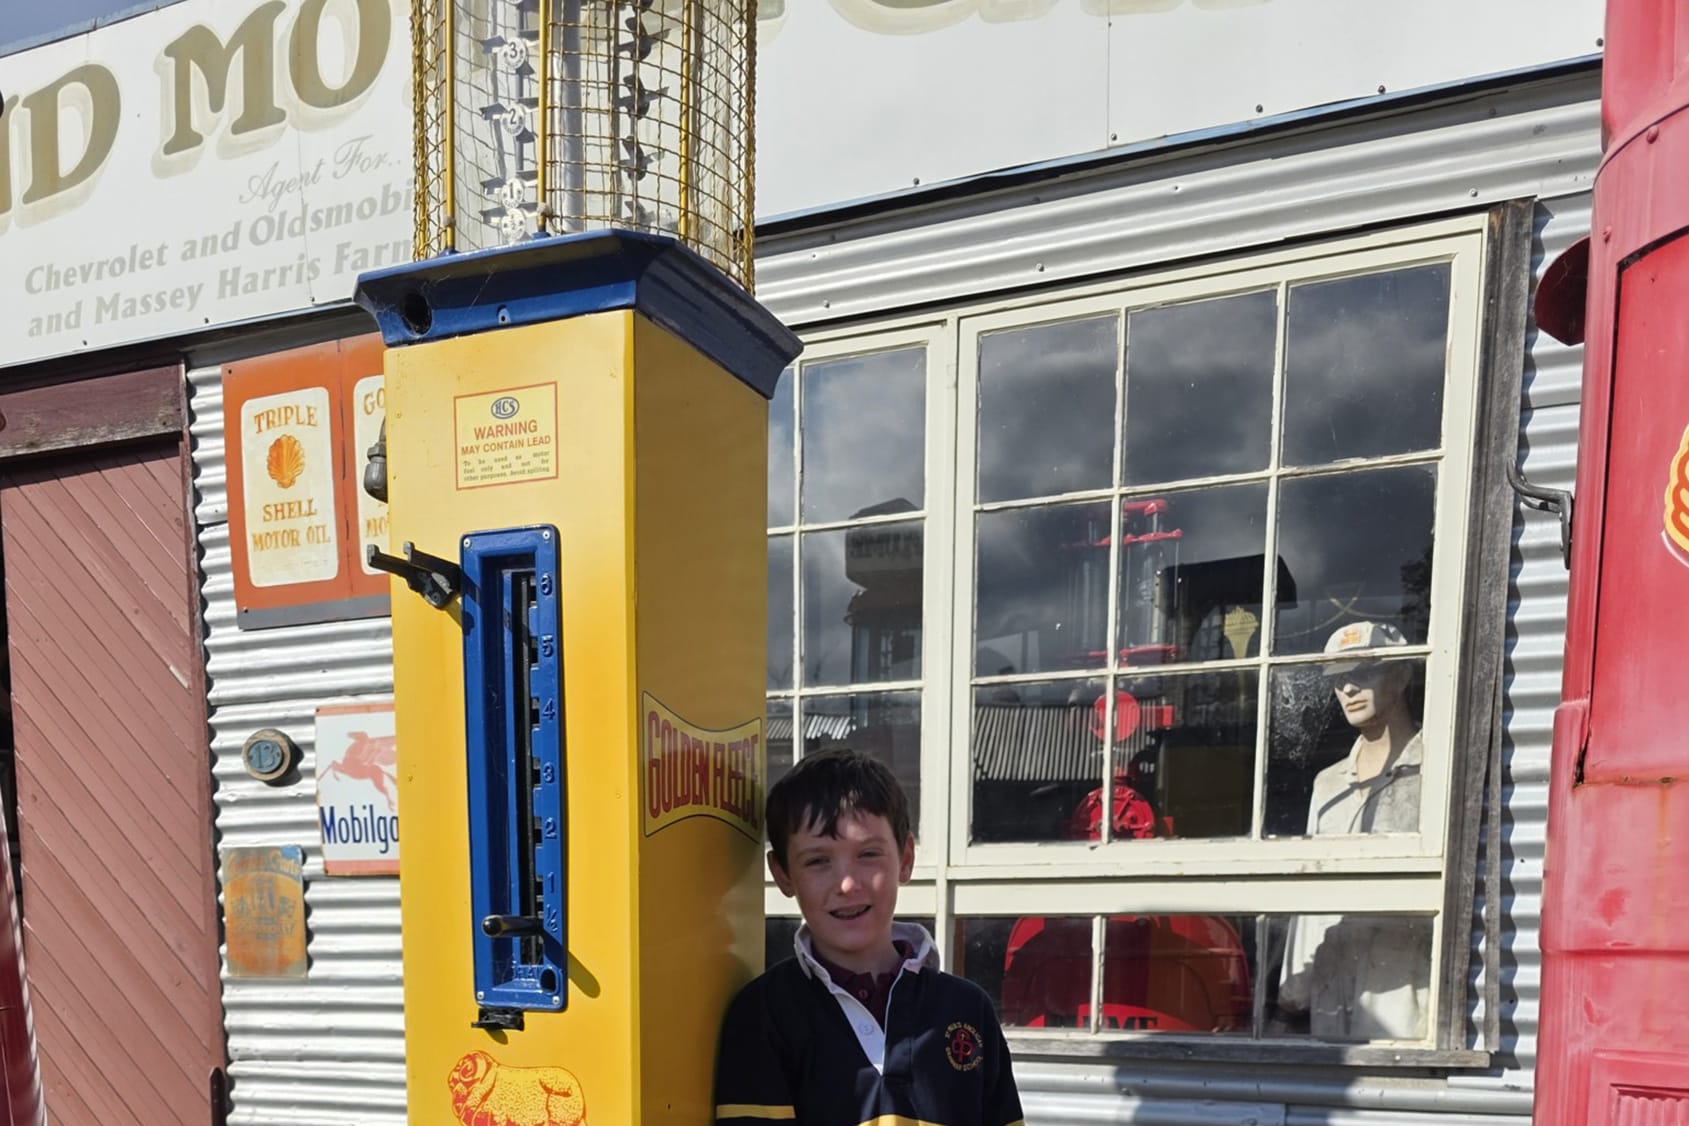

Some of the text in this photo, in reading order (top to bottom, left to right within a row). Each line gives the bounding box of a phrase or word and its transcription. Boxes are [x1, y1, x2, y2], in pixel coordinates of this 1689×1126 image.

[238, 160, 323, 213] Agent
[24, 178, 412, 296] Chevrolet and Oldsmobi
[28, 300, 82, 338] and
[95, 279, 205, 326] Massey
[217, 254, 322, 300] Harris
[254, 404, 318, 434] TRIPLE
[474, 419, 538, 441] WARNING
[461, 435, 551, 456] MAY CONTAIN LEAD
[263, 498, 317, 522] SHELL
[252, 524, 331, 552] MOTOR OIL
[541, 635, 554, 657] 5
[542, 698, 556, 722] 4
[543, 762, 556, 784] 3
[648, 710, 759, 831] GOLDEN FLEECE
[319, 804, 399, 854] Mobilga
[545, 817, 558, 840] 2
[548, 871, 555, 894] 1
